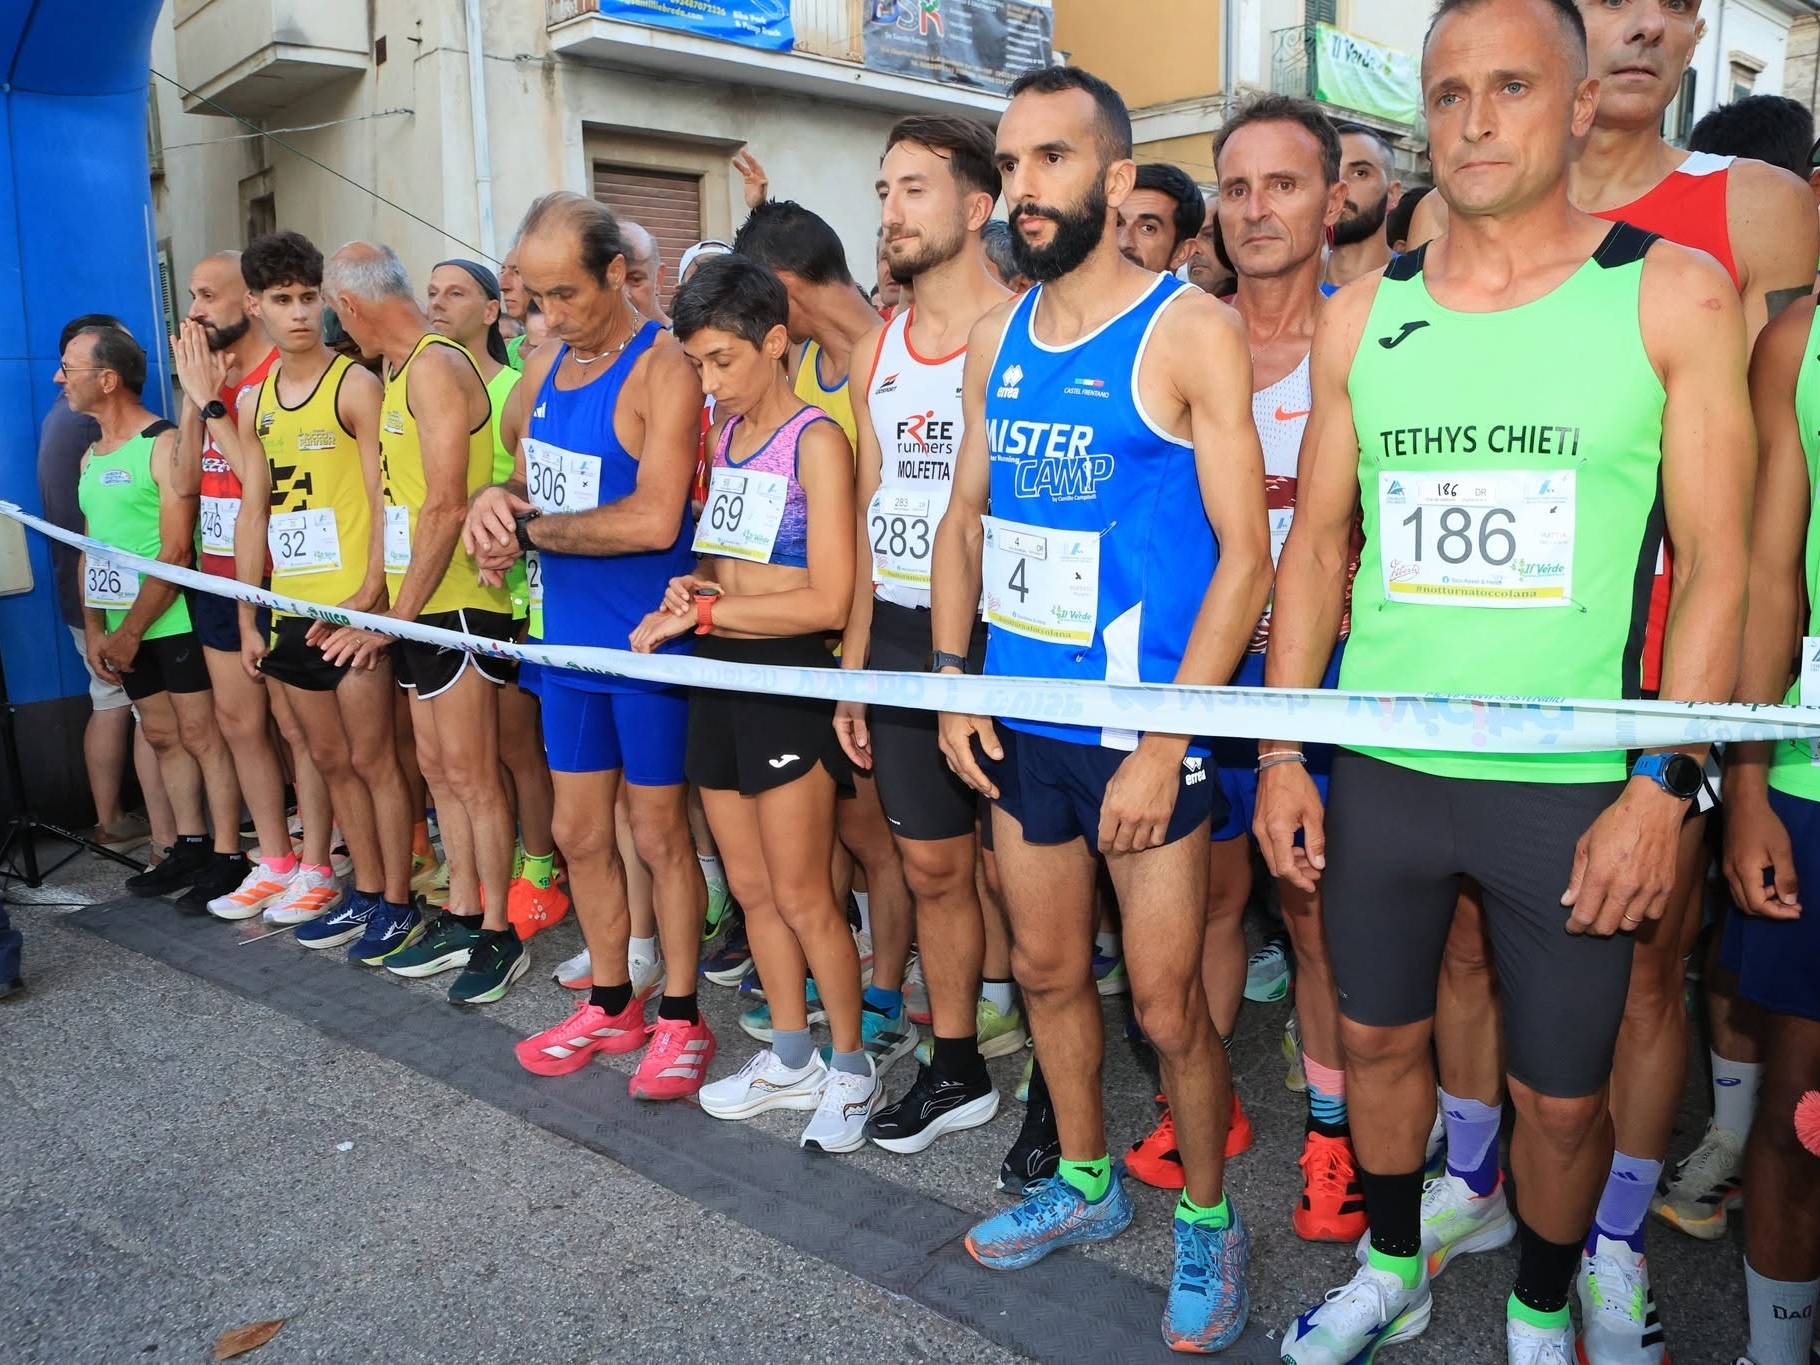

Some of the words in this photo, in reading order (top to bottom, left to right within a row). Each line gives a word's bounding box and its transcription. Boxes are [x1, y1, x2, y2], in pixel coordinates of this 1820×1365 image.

[1064, 387, 1081, 396] CASTEL
[1082, 389, 1110, 398] FRENTANO
[897, 413, 953, 440] FREE
[897, 442, 953, 454] runners
[1380, 425, 1477, 457] TETHYS
[1488, 425, 1580, 456] CHIETI
[529, 461, 566, 506] 306
[898, 460, 950, 481] MOLFETTA
[1015, 453, 1114, 498] CAMP
[1437, 482, 1459, 497] 186
[202, 511, 223, 538] 246
[711, 494, 744, 532] 69
[279, 530, 307, 558] 32
[871, 515, 930, 560] 283
[1403, 505, 1516, 567] 186
[88, 568, 121, 593] 326
[1008, 558, 1029, 603] 4
[1537, 562, 1564, 574] Verde
[1416, 586, 1537, 598] #notturnatoccolana
